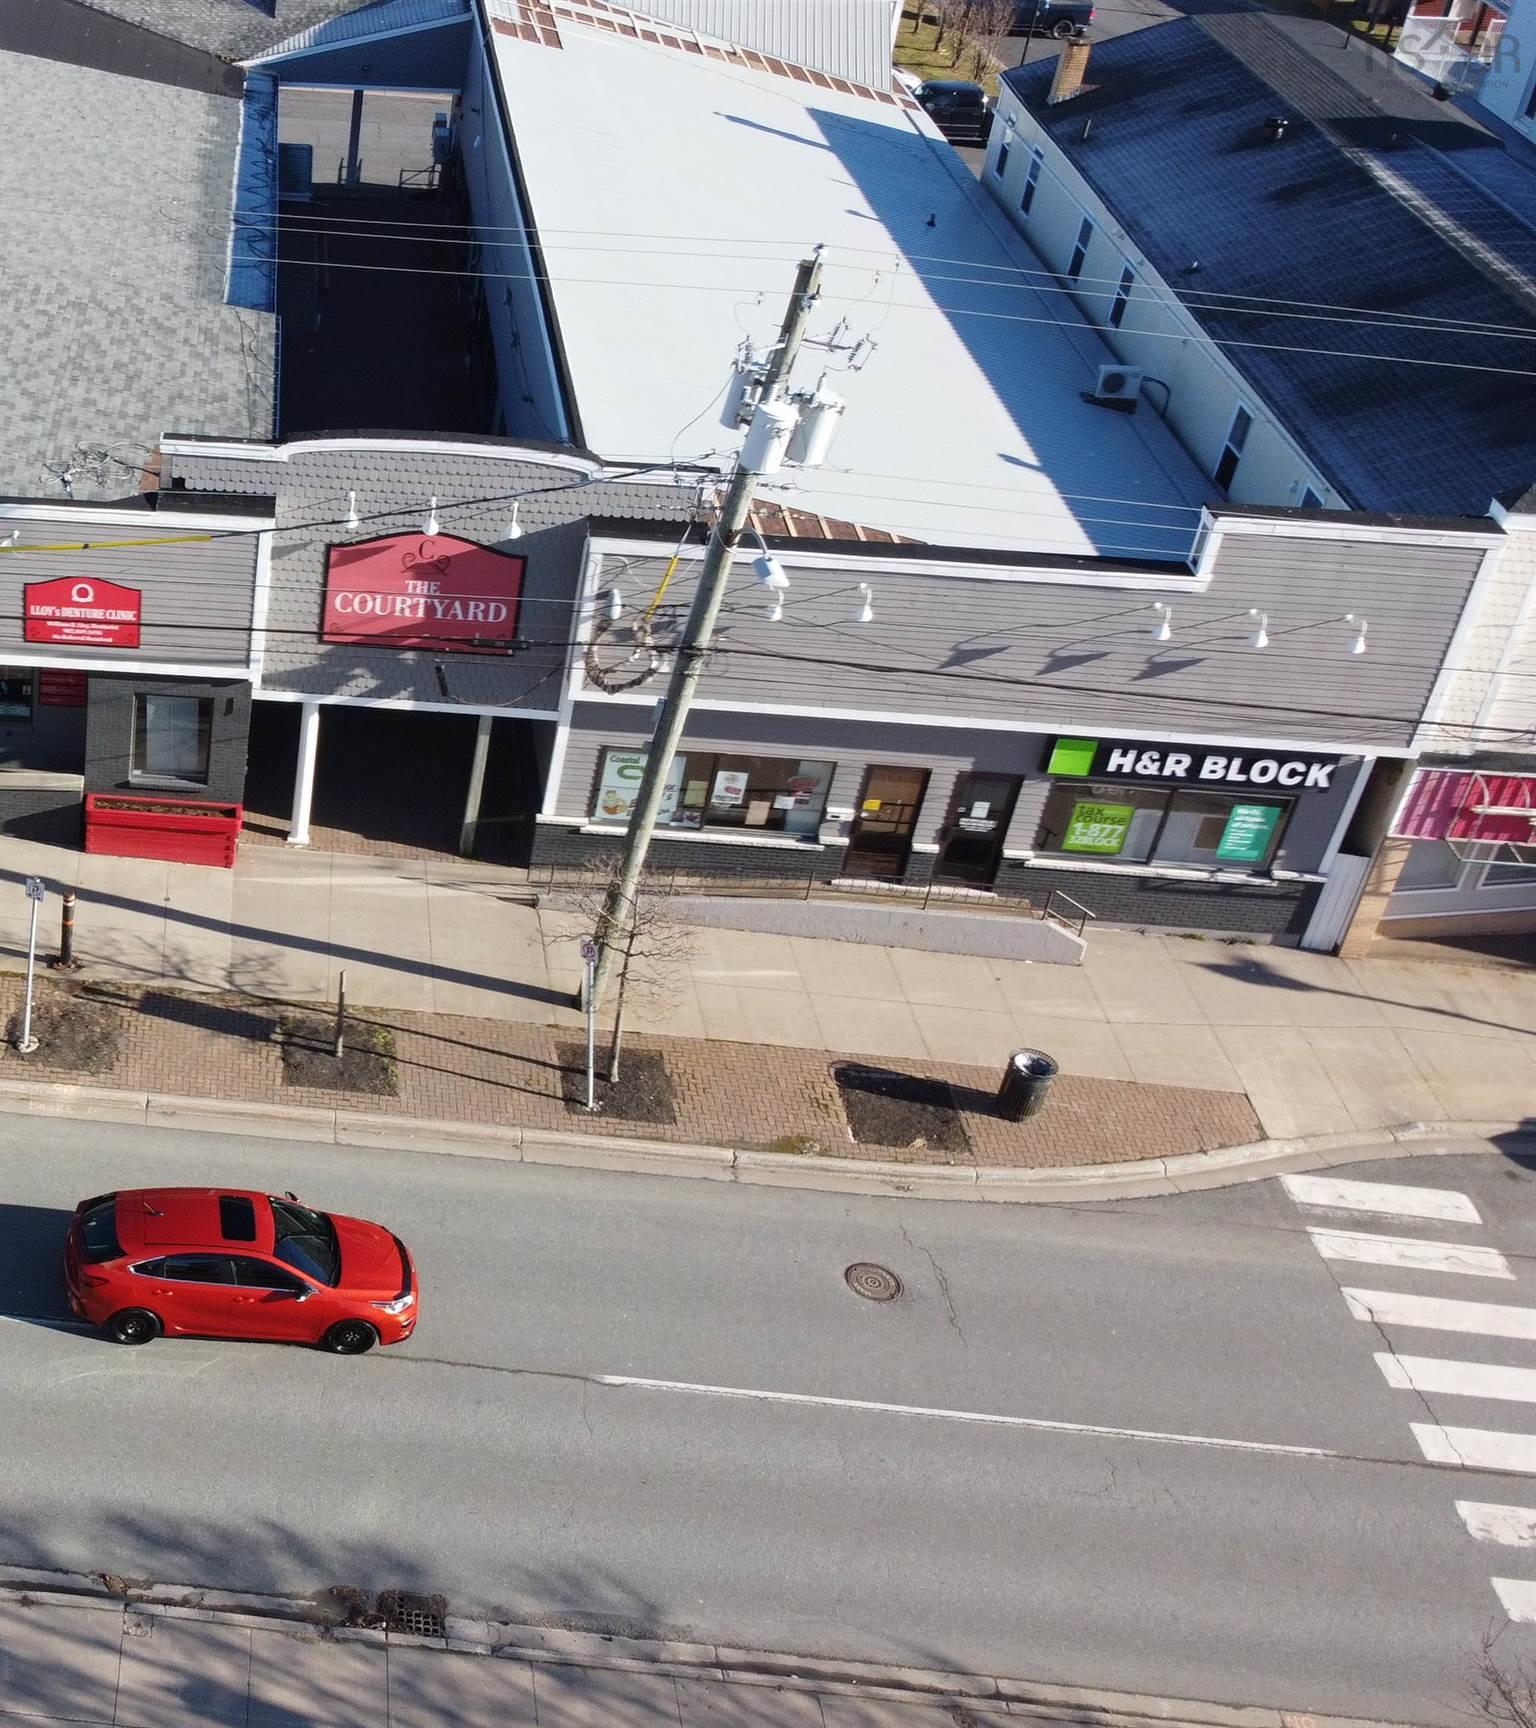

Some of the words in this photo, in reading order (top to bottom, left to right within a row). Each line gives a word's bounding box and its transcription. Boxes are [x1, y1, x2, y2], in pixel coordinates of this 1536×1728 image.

[405, 579, 441, 595] THE
[61, 607, 105, 619] DENTURE
[106, 609, 136, 620] CLINIC
[334, 592, 508, 623] COURTYARD
[1106, 748, 1192, 778] H&R
[1199, 755, 1337, 788] BLOCK
[1078, 805, 1104, 816] tax
[1075, 815, 1126, 825] course
[1072, 822, 1126, 838] 1-877
